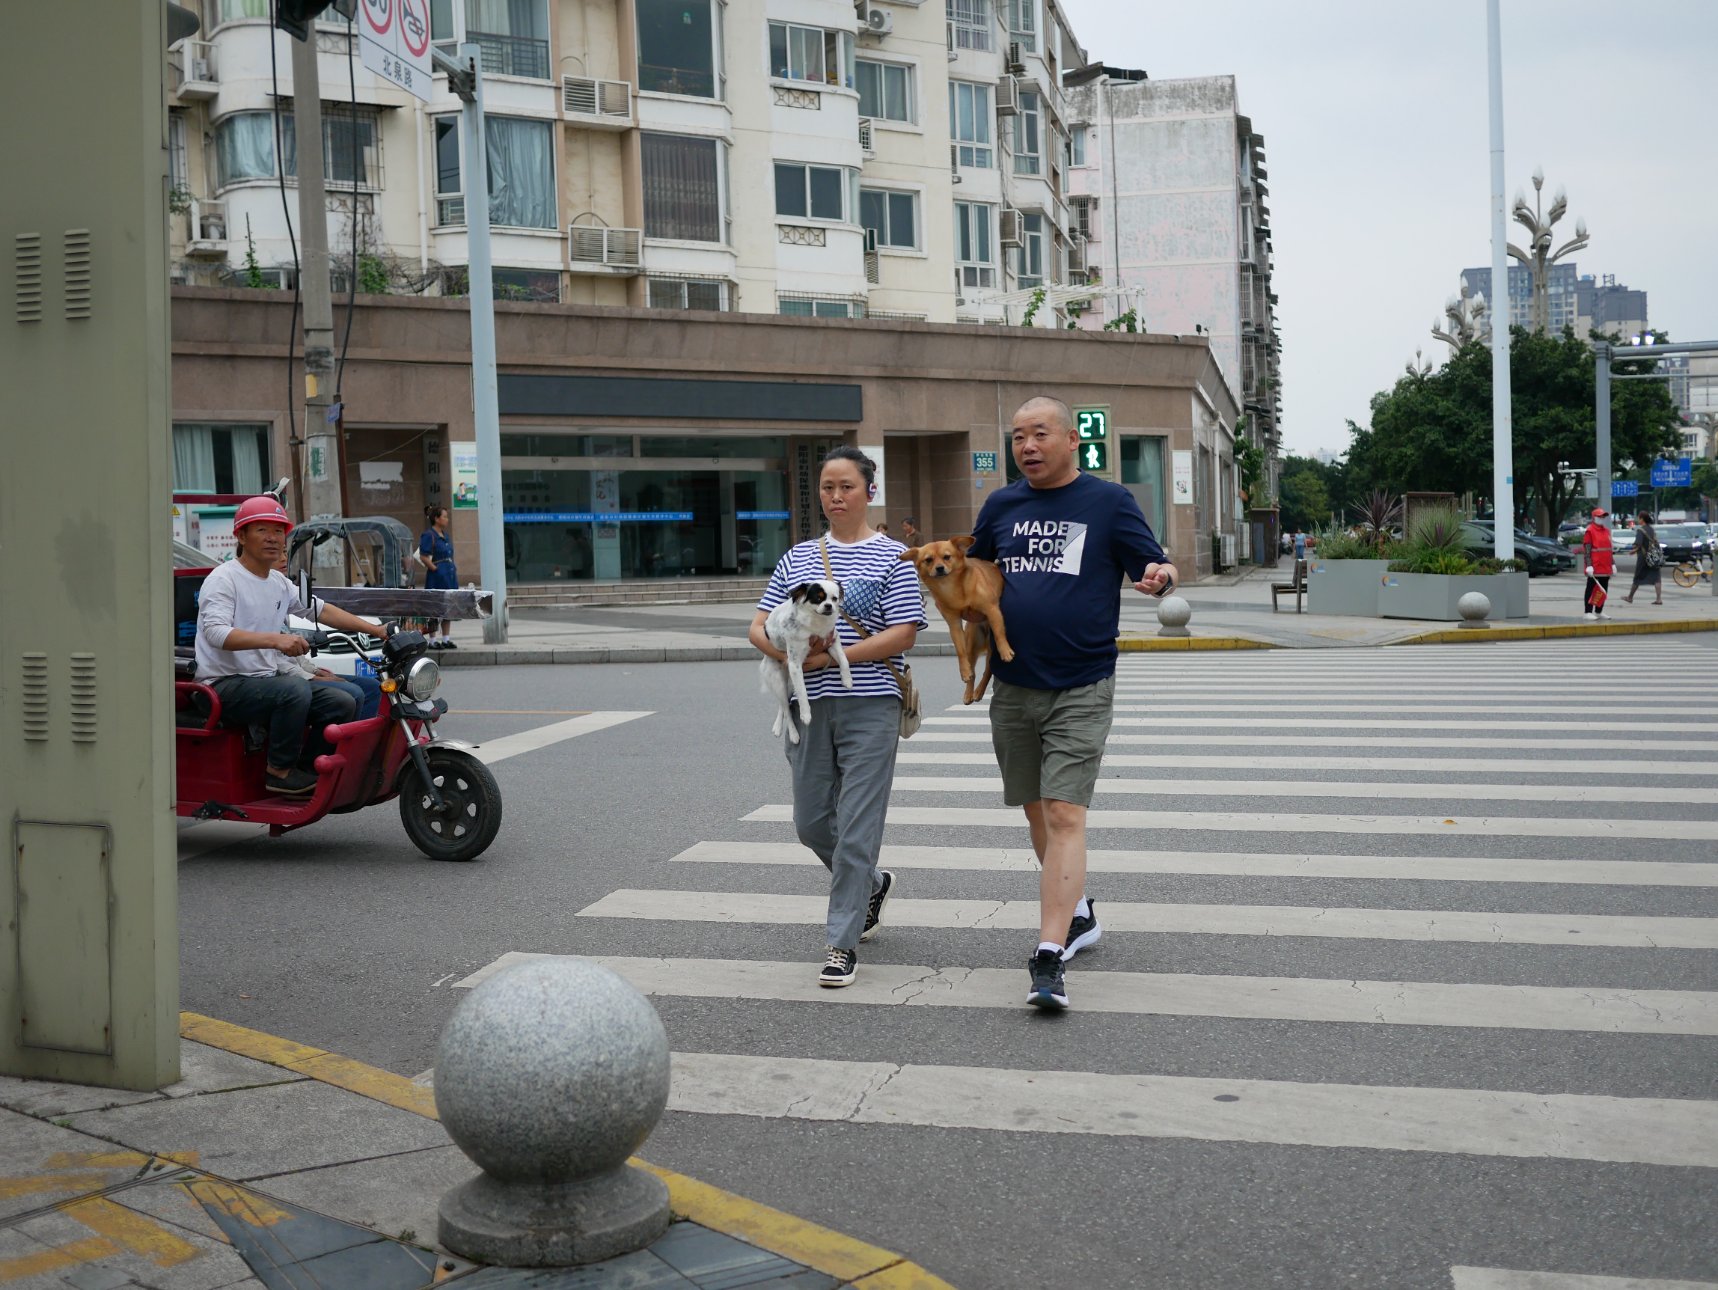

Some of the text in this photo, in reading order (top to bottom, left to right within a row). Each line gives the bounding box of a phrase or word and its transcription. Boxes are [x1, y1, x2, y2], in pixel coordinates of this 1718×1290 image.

[383, 55, 412, 88] 北泉路
[1079, 412, 1105, 437] 27
[976, 457, 993, 467] 355
[1012, 520, 1069, 537] MADE
[1028, 538, 1067, 555] FOR
[1002, 556, 1064, 573] TENNIS
